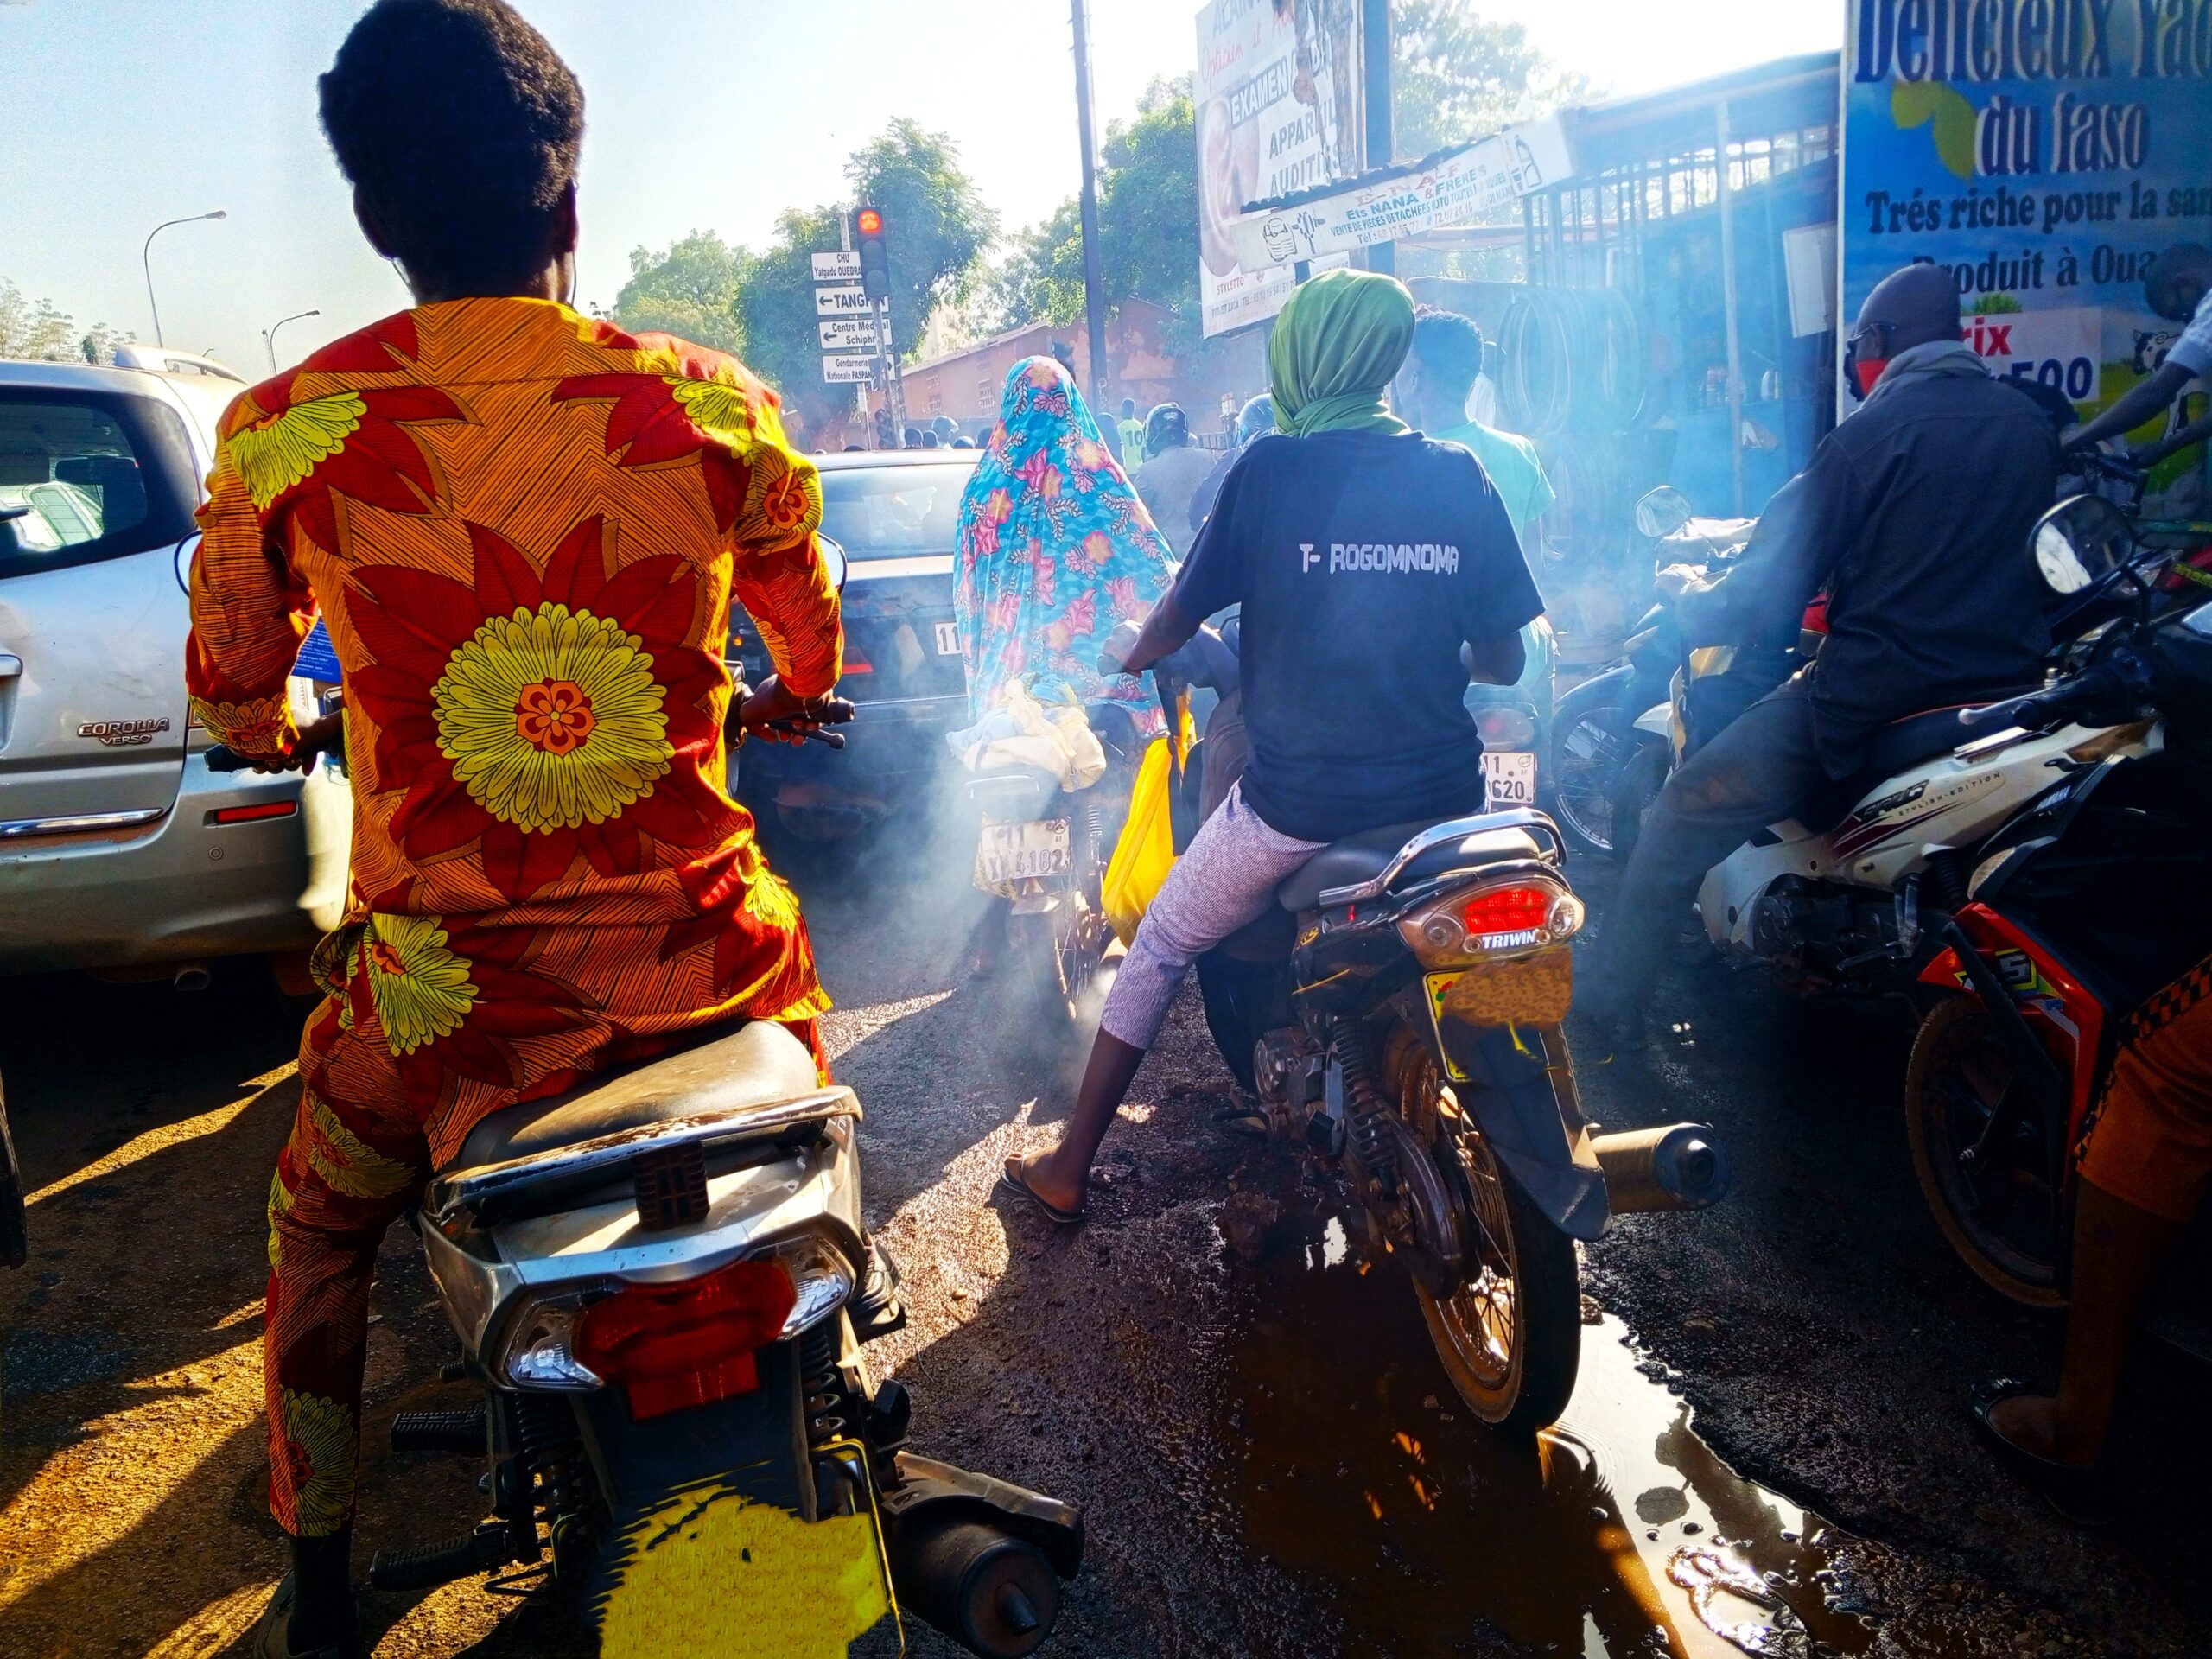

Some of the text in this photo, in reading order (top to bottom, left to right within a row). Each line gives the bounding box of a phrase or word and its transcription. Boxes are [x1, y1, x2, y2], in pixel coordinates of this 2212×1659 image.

[1231, 60, 1287, 119] EXAMEN
[1975, 92, 2150, 175] du faso
[1346, 164, 1486, 220] Ets NANA & FRERES
[1866, 188, 1942, 234] Trés
[1948, 185, 2034, 229] riche
[2042, 187, 2122, 234] pour
[2130, 180, 2158, 219] la
[1331, 223, 1352, 237] VENTE
[1352, 221, 1362, 232] DE
[1363, 215, 1386, 229] PIECES
[1387, 202, 1431, 224] DETACHEES
[837, 253, 849, 263] CHU
[2056, 246, 2079, 286] à
[2091, 245, 2156, 286] Oua
[815, 266, 836, 278] Yalgado
[1217, 276, 1244, 296] STYLETTO
[832, 320, 889, 333] Centre Médal
[846, 334, 876, 345] Schiphr
[836, 358, 868, 368] Gendarmerie
[827, 370, 850, 380] Nationale
[1125, 430, 1143, 447] 10
[1299, 543, 1459, 575] T- ROGOMNOMA
[940, 626, 960, 651] 11
[77, 717, 170, 737] COROLLA
[99, 733, 153, 746] VERSO
[1482, 930, 1535, 950] TRIWIN
